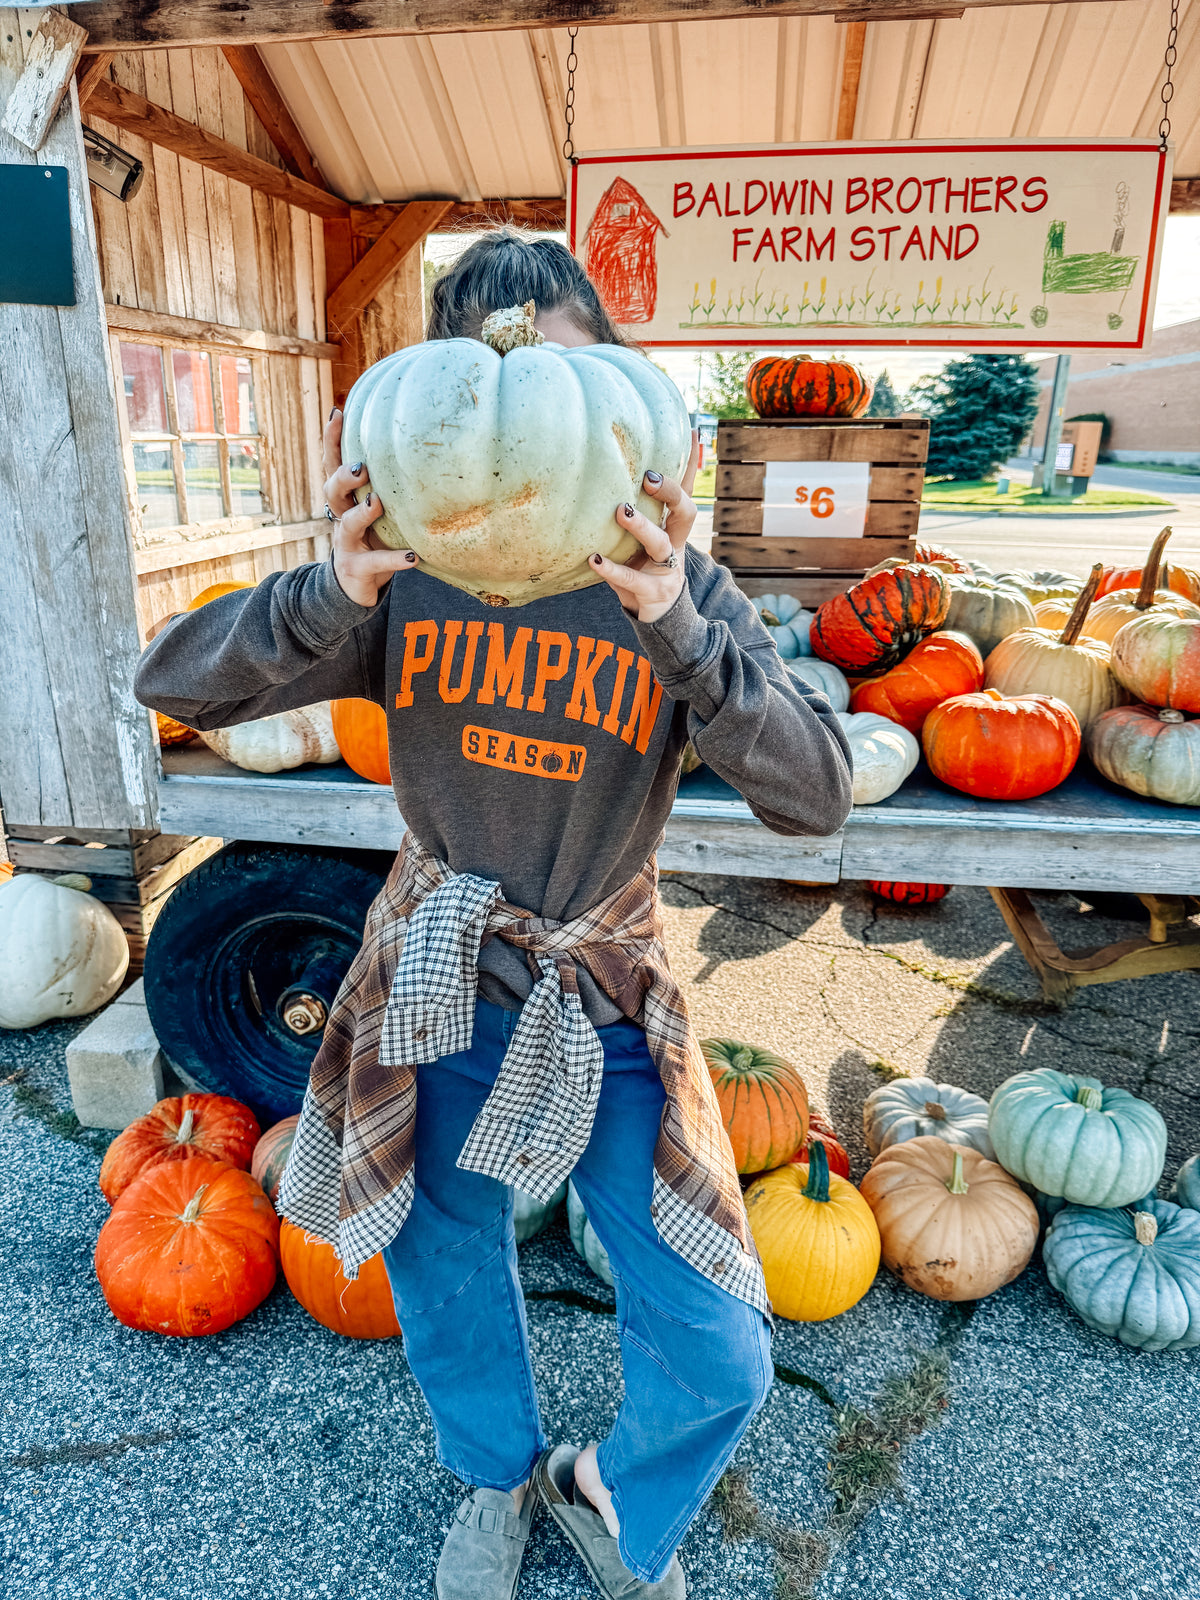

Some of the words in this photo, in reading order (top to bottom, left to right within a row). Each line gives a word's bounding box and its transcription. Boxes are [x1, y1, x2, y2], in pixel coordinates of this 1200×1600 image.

[673, 179, 832, 218] BALDWIN
[846, 176, 1048, 214] BROTHERS
[732, 226, 835, 263] FARM
[850, 224, 979, 262] STAND
[795, 486, 835, 519] $6
[395, 619, 663, 756] PUMPKIN
